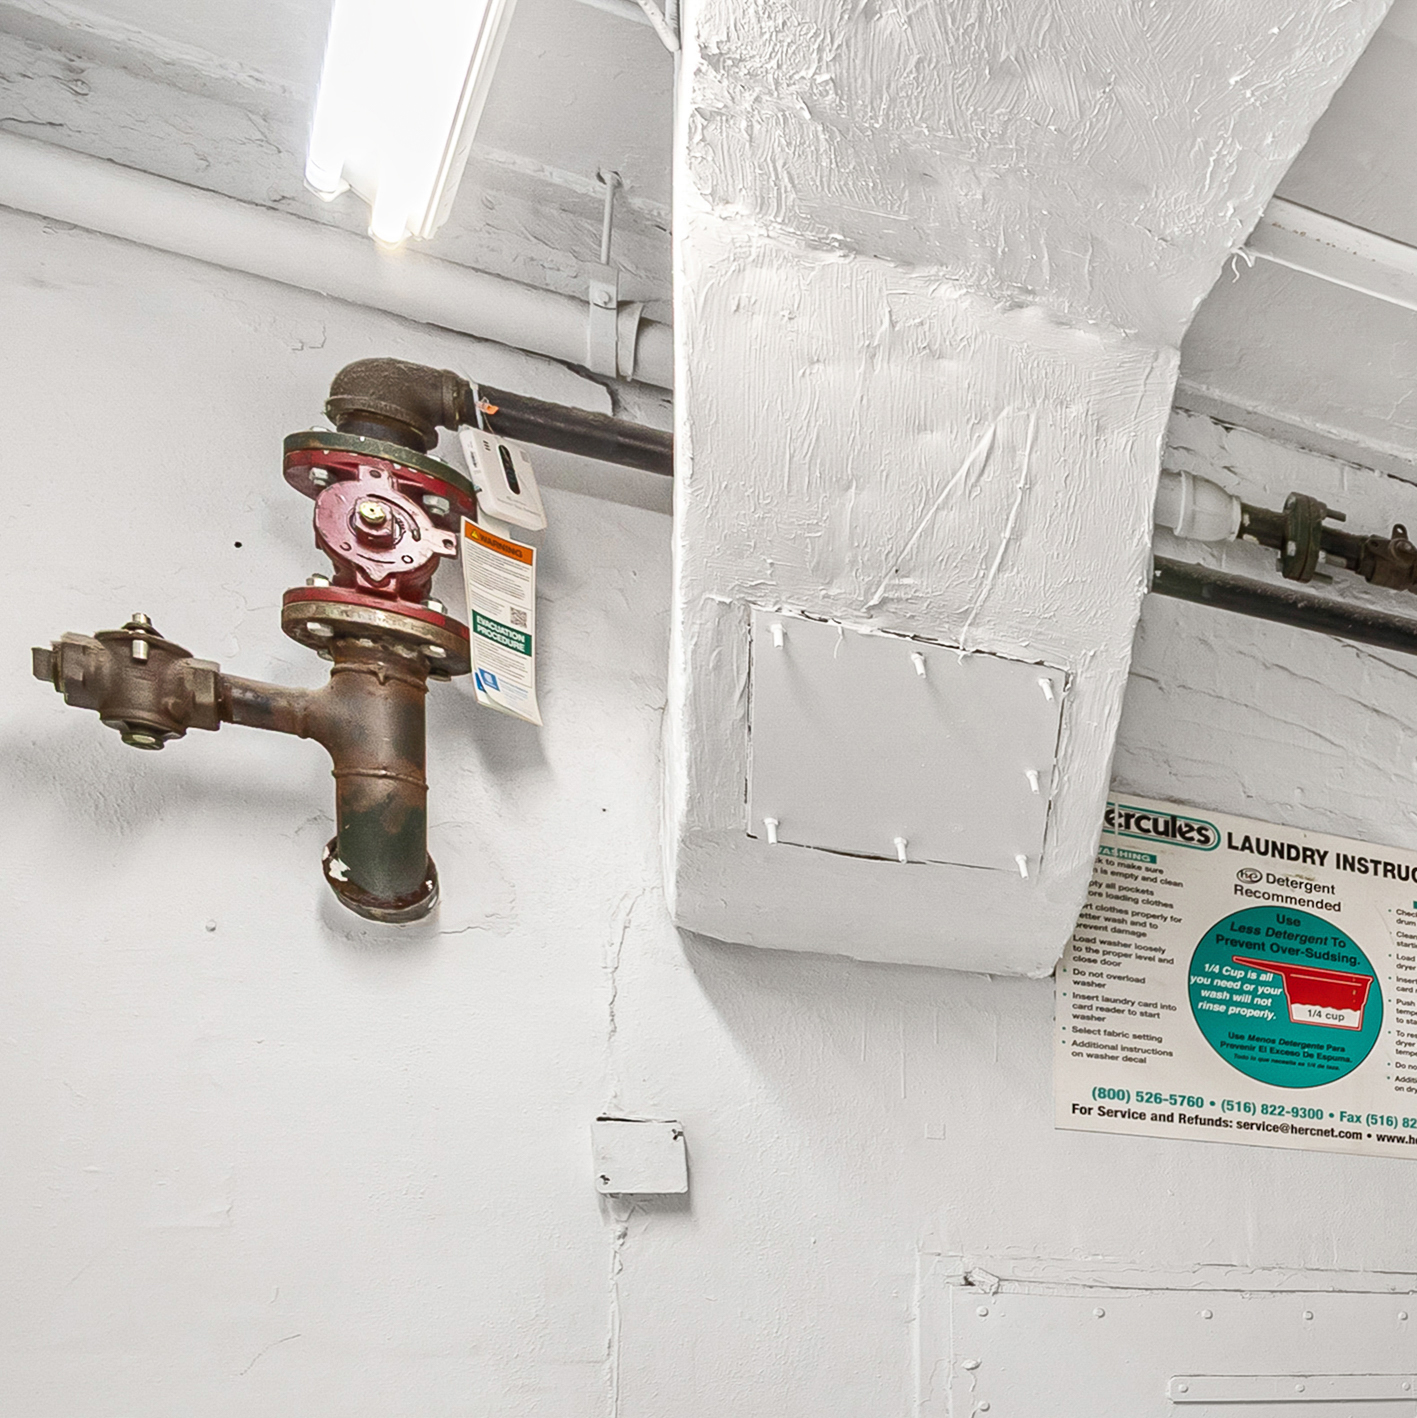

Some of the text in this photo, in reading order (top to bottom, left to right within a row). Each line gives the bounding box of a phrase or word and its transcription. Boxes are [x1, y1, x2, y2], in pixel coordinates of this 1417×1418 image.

[480, 534, 523, 558] WARNING
[476, 616, 525, 641] EVACUATION
[477, 625, 525, 652] PROCEDURE
[1104, 809, 1211, 844] ercules
[1227, 832, 1328, 866] LAUNDRY
[1266, 873, 1336, 895] Detergent
[1234, 884, 1341, 912] Recommended
[1276, 914, 1301, 927] Use
[1073, 934, 1166, 954] Load washer loosely
[1230, 922, 1346, 949] Less Detergent To
[1102, 949, 1133, 959] proper
[1135, 953, 1155, 962] level
[1158, 957, 1174, 965] and
[1216, 934, 1360, 967] Prevent Over-Sudsing.
[1073, 955, 1122, 967] close door
[1073, 968, 1086, 976] Do
[1106, 974, 1146, 984] overload
[1204, 963, 1274, 982] 1/4 Cup is all
[1072, 980, 1106, 988] washer
[1190, 975, 1283, 996] you need or your
[1072, 992, 1177, 1011] Insert laundry card into
[1201, 989, 1272, 1007] wash will not
[1072, 1014, 1106, 1022] washer
[1198, 1001, 1277, 1021] rinse properly.
[1308, 1009, 1345, 1022] 1/4 cup
[1072, 1026, 1163, 1043] Select fabric setting
[1071, 1040, 1173, 1057] Additional instructions
[1086, 1053, 1120, 1061] washer
[1122, 1055, 1146, 1064] decal
[1092, 1086, 1130, 1104] (800)
[1135, 1091, 1204, 1108] 526-5760
[1221, 1099, 1256, 1115] (516)
[1260, 1103, 1324, 1120] 822-9300
[1340, 1111, 1362, 1123] Fax
[1366, 1113, 1398, 1129] (516)
[1072, 1103, 1094, 1116] For
[1097, 1105, 1146, 1121] Service
[1150, 1113, 1174, 1123] and
[1179, 1113, 1233, 1128] Refunds:
[1236, 1118, 1363, 1141] service@hercnet.com
